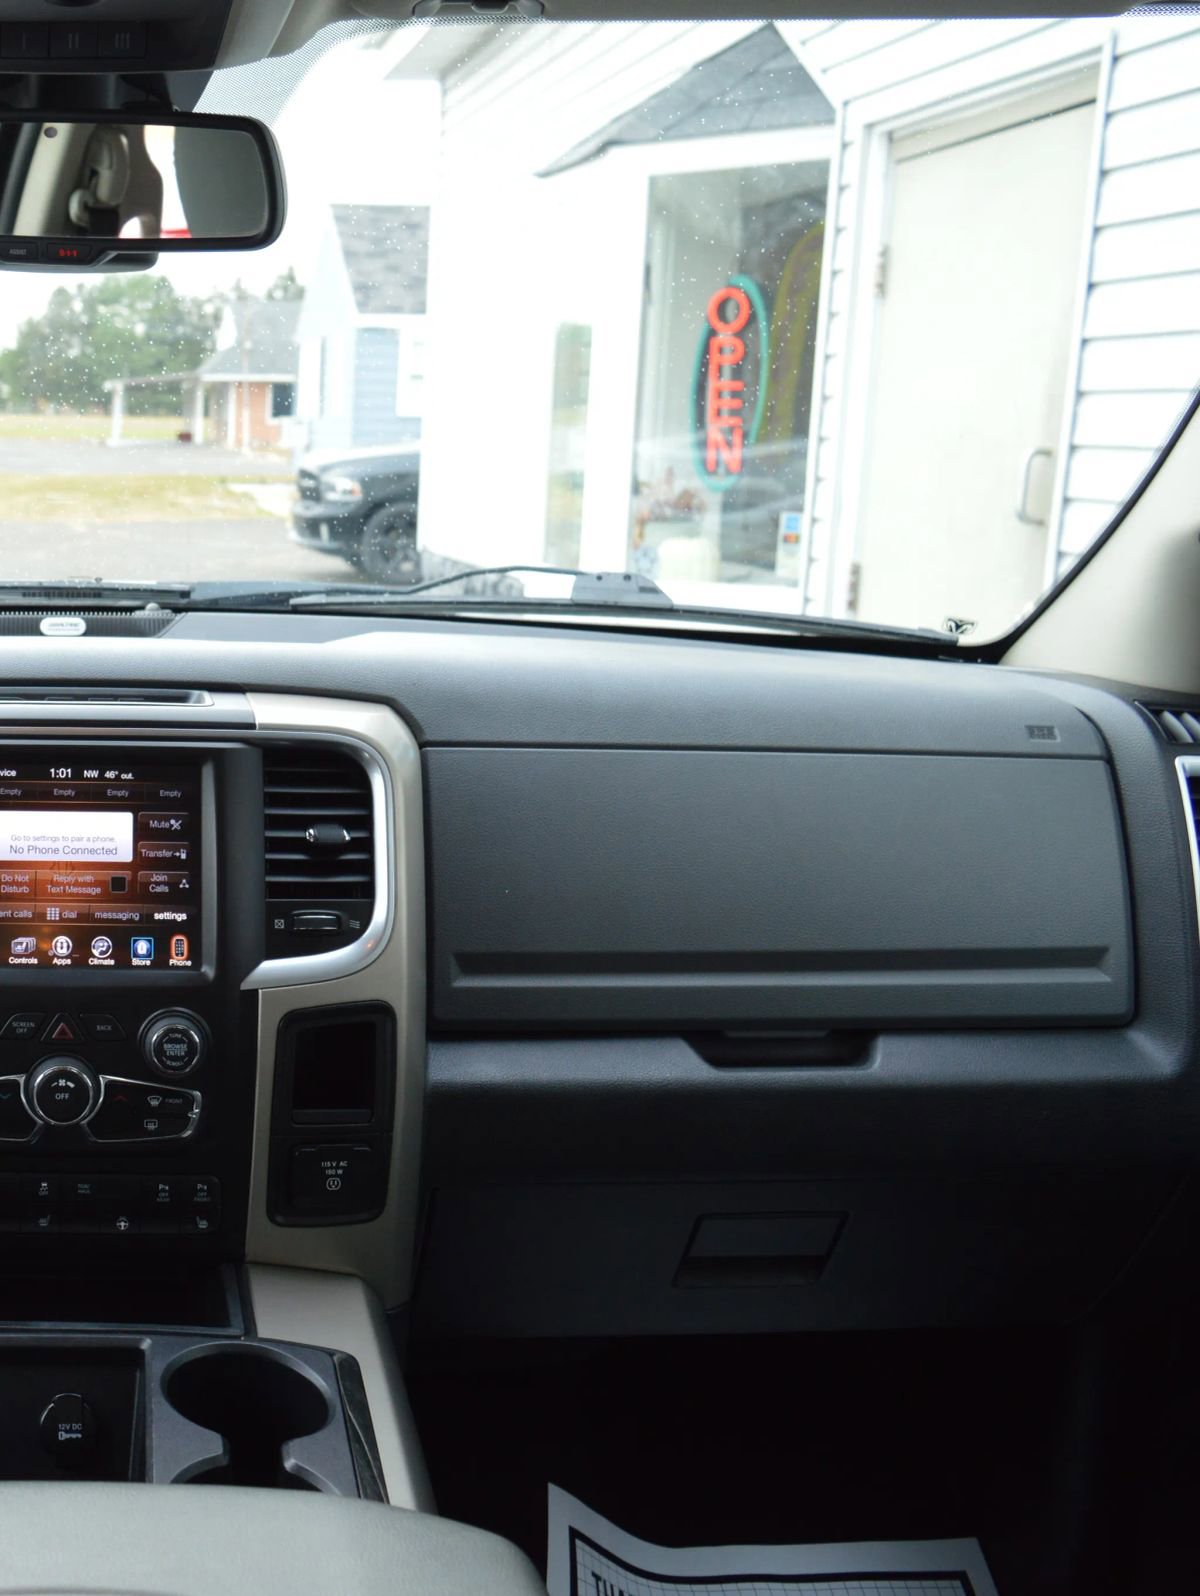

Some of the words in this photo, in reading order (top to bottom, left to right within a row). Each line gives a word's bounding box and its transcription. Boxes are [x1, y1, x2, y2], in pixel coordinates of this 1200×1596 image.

[706, 286, 751, 473] OPEN
[49, 767, 72, 778] 1:01
[83, 769, 99, 778] NW
[104, 770, 119, 779] 46°
[0, 787, 23, 796] Empty
[53, 788, 76, 797] Empty
[107, 789, 130, 798] Empty
[159, 789, 182, 798] Empty
[149, 820, 170, 829] Mute
[10, 834, 22, 842] Go
[32, 835, 60, 843] settings
[70, 835, 85, 843] pair
[9, 844, 25, 855] No
[27, 844, 60, 855] Phone
[62, 845, 118, 856] Connected
[141, 849, 174, 858] Transfer
[1, 873, 13, 882] Do
[14, 873, 29, 882] Not
[53, 874, 76, 884] Reply
[77, 874, 95, 883] with
[150, 873, 168, 882] Join
[0, 884, 30, 893] Disturb
[46, 884, 64, 893] Text
[65, 885, 102, 895] Message
[148, 884, 169, 893] Calls
[13, 909, 33, 918] calls
[61, 910, 78, 919] dial
[94, 911, 140, 921] messaging
[153, 911, 187, 922] settings
[8, 956, 38, 965] Controls
[52, 957, 72, 966] Apps
[88, 958, 115, 966] Climate
[131, 958, 151, 966] Store
[169, 958, 192, 967] Phone
